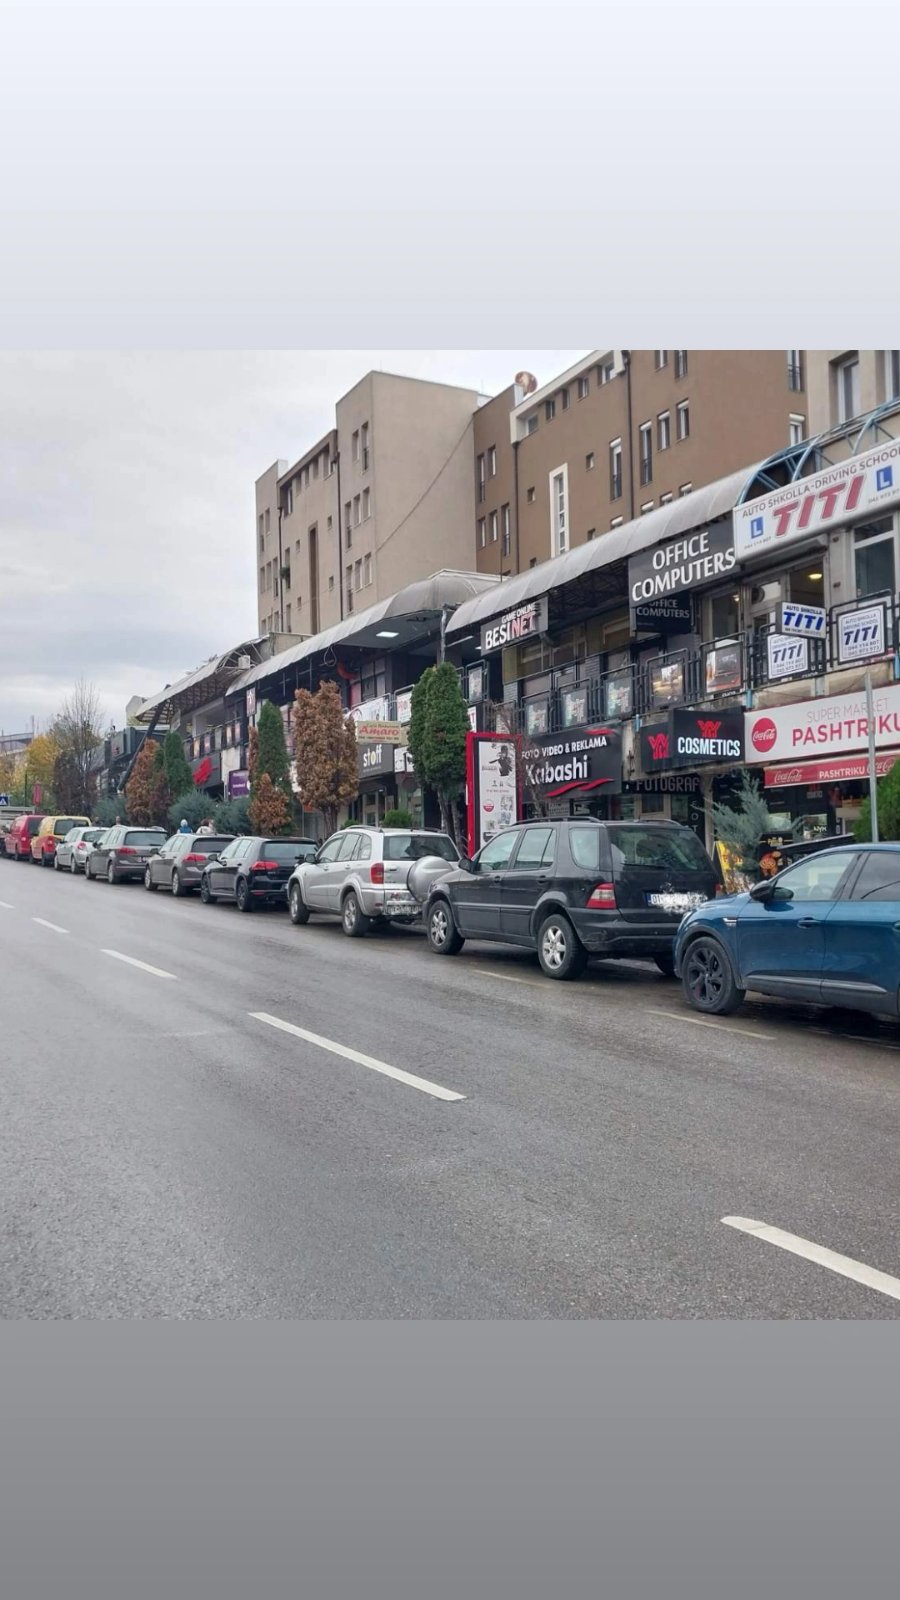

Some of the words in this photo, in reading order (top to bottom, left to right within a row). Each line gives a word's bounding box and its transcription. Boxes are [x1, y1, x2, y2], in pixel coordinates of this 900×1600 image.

[742, 503, 767, 518] AUTO
[859, 447, 900, 471] SCHOO
[773, 475, 865, 537] TITI
[652, 532, 709, 570] OFFICE
[631, 547, 736, 602] COMPUTERS
[501, 611, 517, 624] GAME
[516, 601, 536, 617] ONLINE
[636, 606, 690, 618] COMPUTERS
[783, 611, 824, 631] TITI
[843, 624, 879, 646] TITI
[772, 643, 803, 664] TITI
[806, 706, 841, 723] SUPER
[844, 697, 889, 718] MARET
[363, 744, 383, 768] stoff
[521, 749, 539, 759] FOTO
[541, 744, 564, 757] VIDEO
[565, 743, 571, 753] &
[571, 736, 607, 752] REKLAMA
[677, 737, 741, 757] COSMETICS
[525, 754, 588, 786] Kabashi
[819, 766, 866, 780] PASHTRIKU
